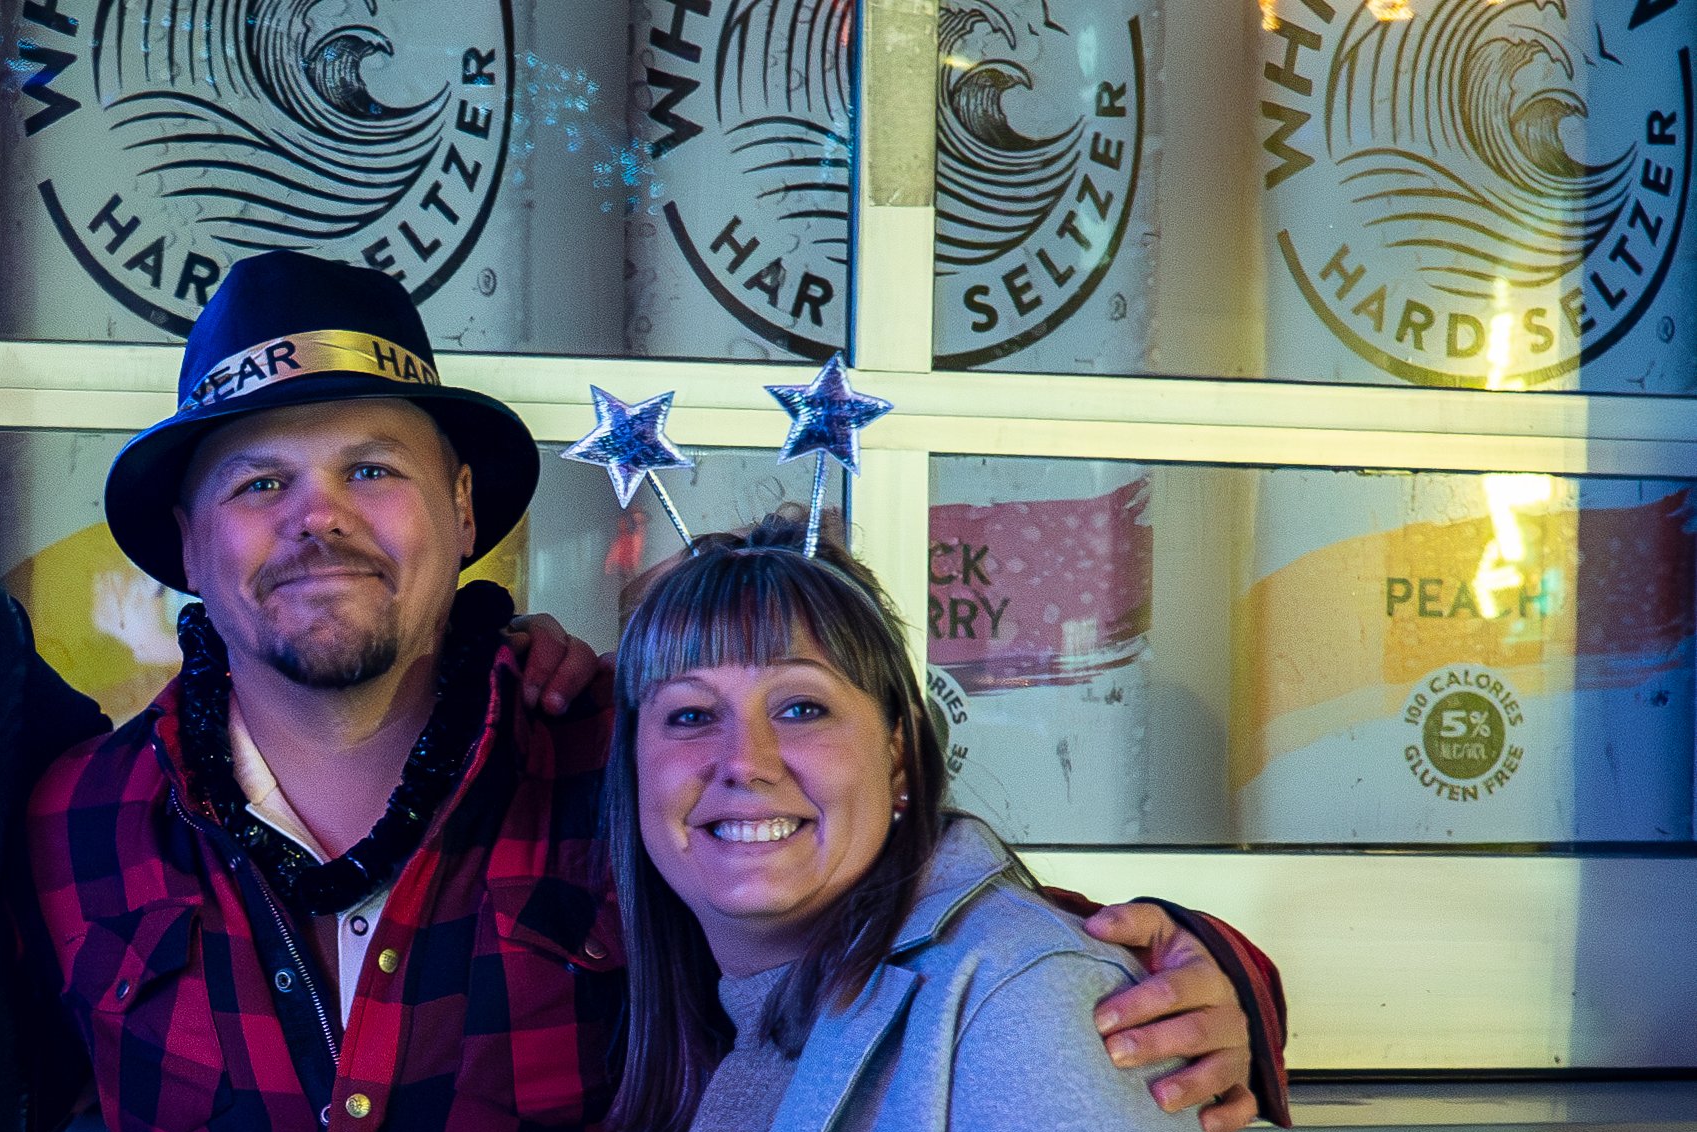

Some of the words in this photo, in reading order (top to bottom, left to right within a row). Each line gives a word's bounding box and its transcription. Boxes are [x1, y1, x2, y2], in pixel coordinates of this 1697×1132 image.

[88, 191, 219, 307] HAR
[347, 46, 496, 283] ELTZER
[710, 215, 834, 327] HAR
[964, 82, 1128, 333] SELTZER
[1320, 243, 1485, 359] HARD
[1523, 109, 1678, 355] SELTZER
[1387, 577, 1548, 618] PEAH
[1404, 692, 1428, 727] 100
[1429, 669, 1524, 727] CALORIES
[1439, 709, 1492, 738] 5%
[1404, 744, 1479, 802] GLUTEN
[1482, 744, 1525, 795] FREE
